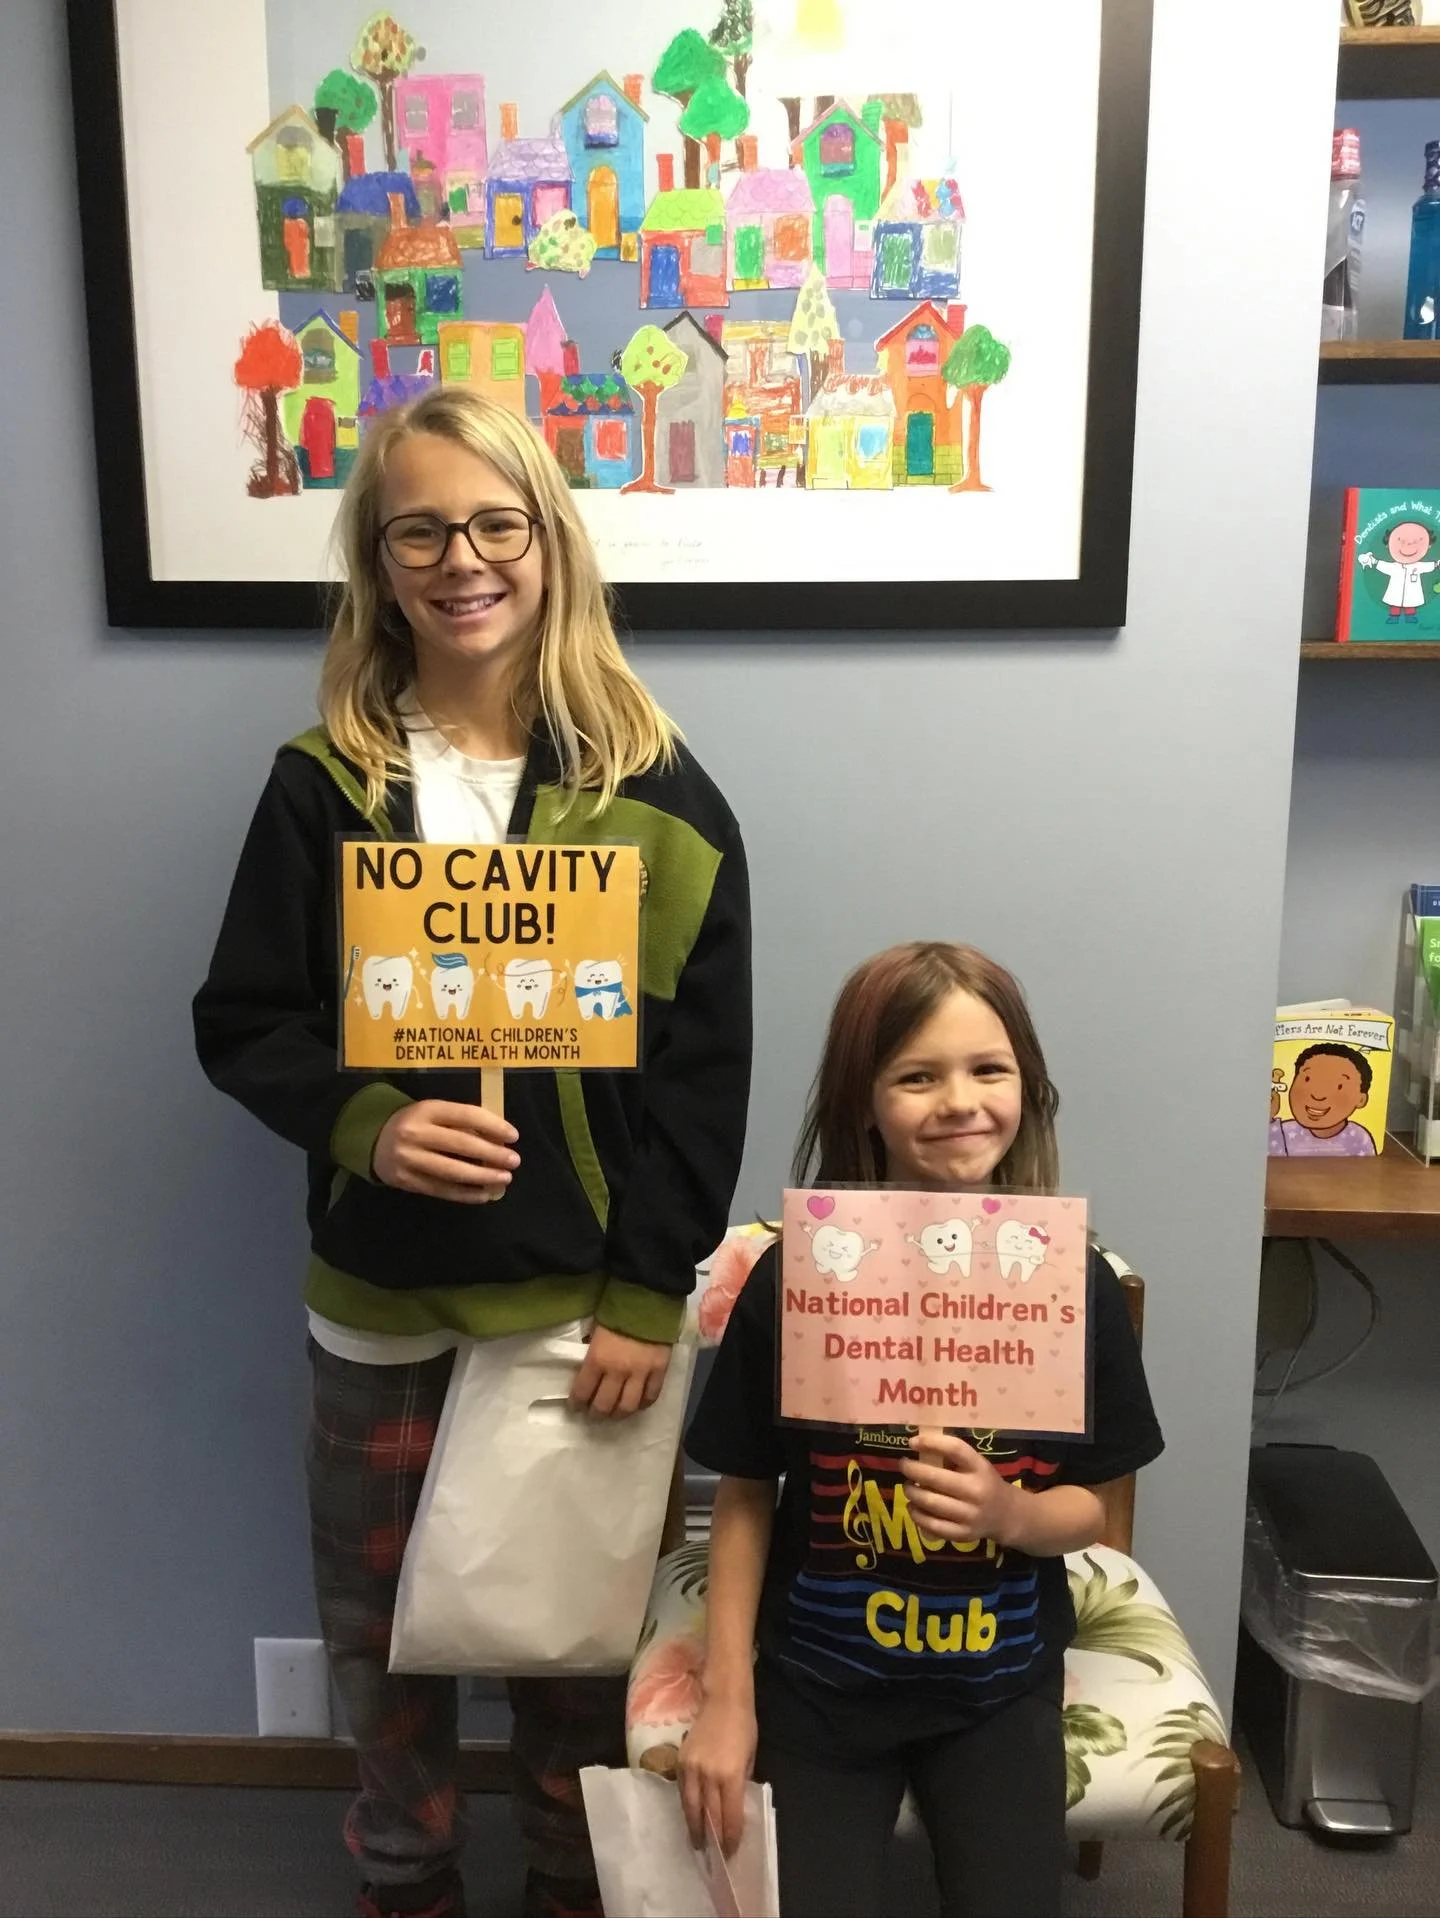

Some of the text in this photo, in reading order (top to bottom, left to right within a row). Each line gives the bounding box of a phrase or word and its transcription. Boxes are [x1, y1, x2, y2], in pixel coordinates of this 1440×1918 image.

[1354, 512, 1388, 544] Dentists
[1390, 501, 1407, 514] and
[1411, 501, 1432, 515] What
[356, 847, 422, 890] NO
[445, 848, 616, 892] CAVITY
[423, 902, 555, 945] CLUB!
[393, 1028, 578, 1043] #NATIONAL CHILDREN'S
[1305, 1024, 1323, 1034] Are
[1326, 1024, 1345, 1036] Not
[1348, 1024, 1385, 1041] Forever
[396, 1045, 580, 1060] DENTAL HEALTH MONTH
[786, 1288, 1076, 1324] National Children's
[824, 1333, 1034, 1366] Dental Health
[877, 1378, 978, 1407] Month
[855, 1428, 911, 1446] Jambore
[866, 1590, 997, 1653] Club
